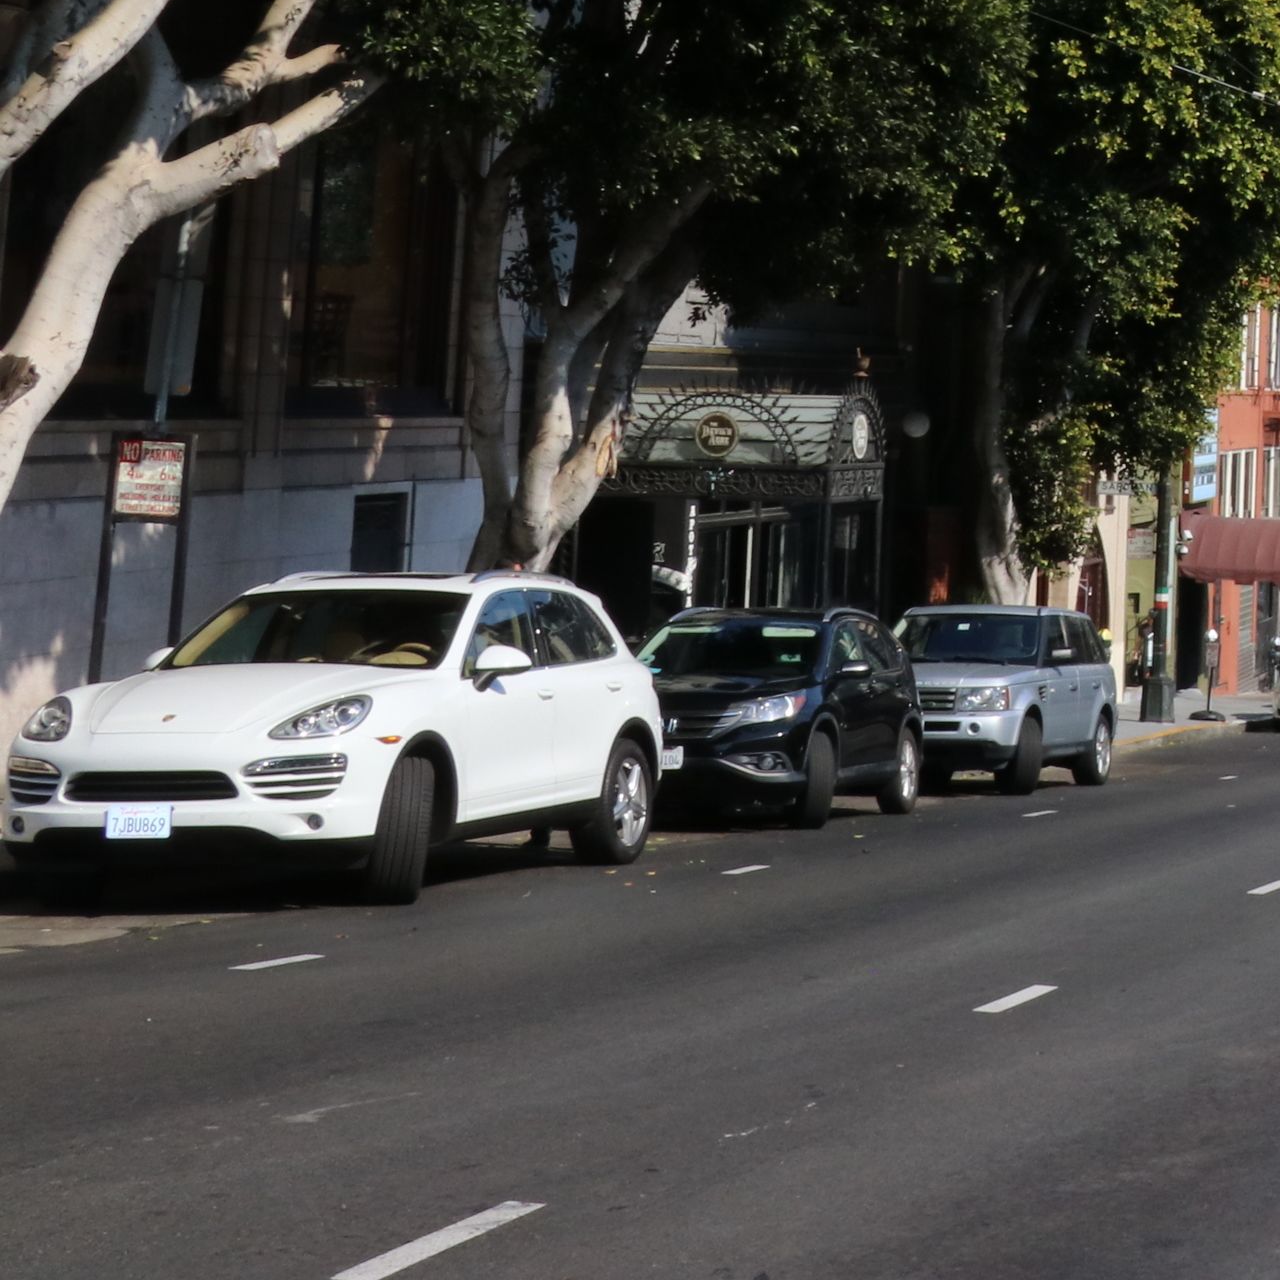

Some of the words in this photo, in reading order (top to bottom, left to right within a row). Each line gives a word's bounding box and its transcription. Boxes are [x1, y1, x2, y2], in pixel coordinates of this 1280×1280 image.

[123, 442, 139, 460] NO
[144, 449, 183, 462] PARKING
[1101, 481, 1154, 492] SAROAN
[112, 817, 166, 833] 7JBU869
